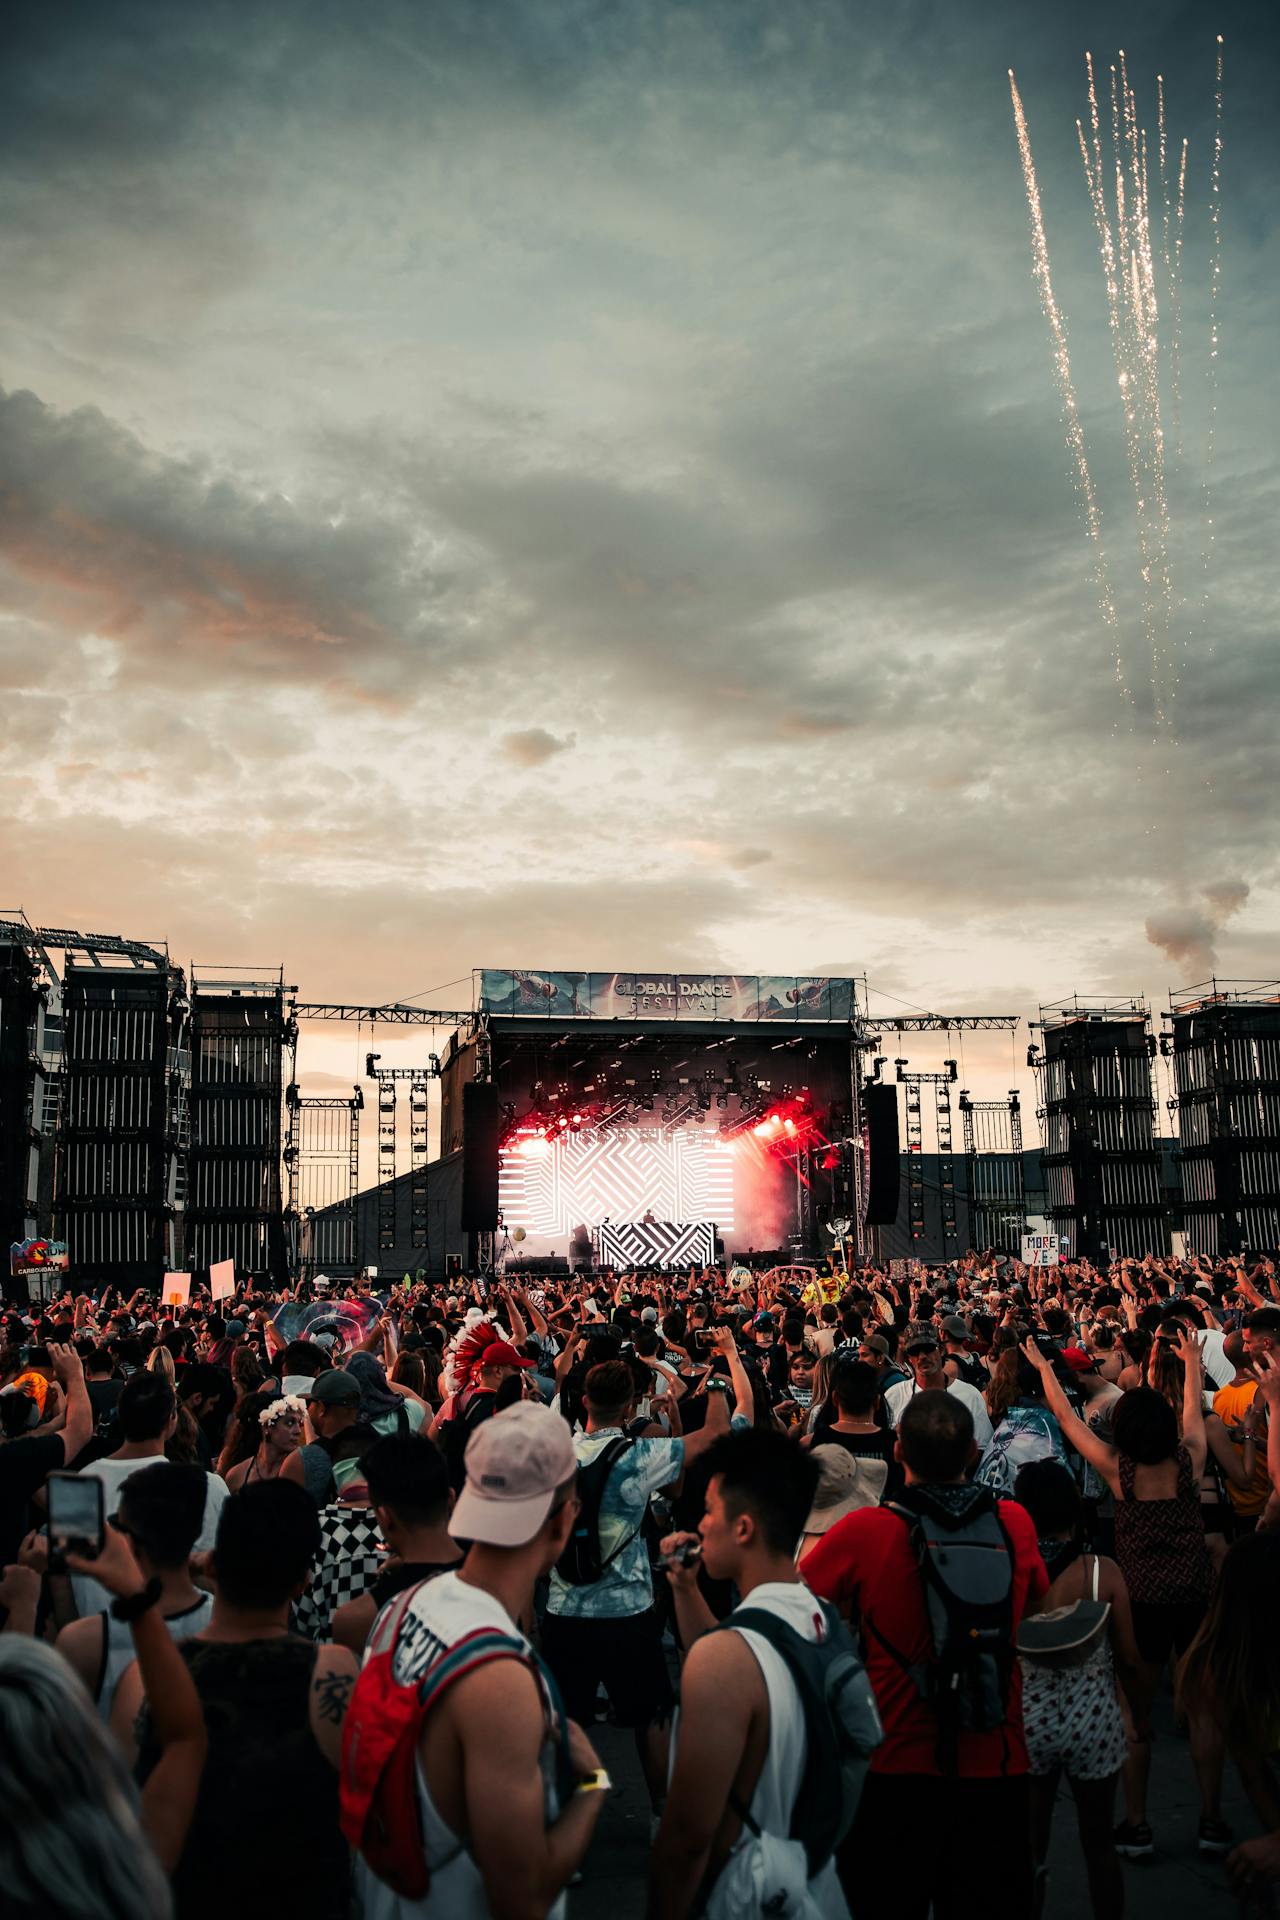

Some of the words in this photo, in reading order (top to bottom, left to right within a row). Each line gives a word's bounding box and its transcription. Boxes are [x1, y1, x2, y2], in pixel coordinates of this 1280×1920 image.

[615, 983, 676, 996] GLOBAL
[679, 984, 732, 998] DANCE
[630, 997, 717, 1010] FESTIVAL
[1027, 1236, 1056, 1249] MORE
[17, 1265, 60, 1274] CARBONDALE
[315, 1671, 354, 1724] 家
